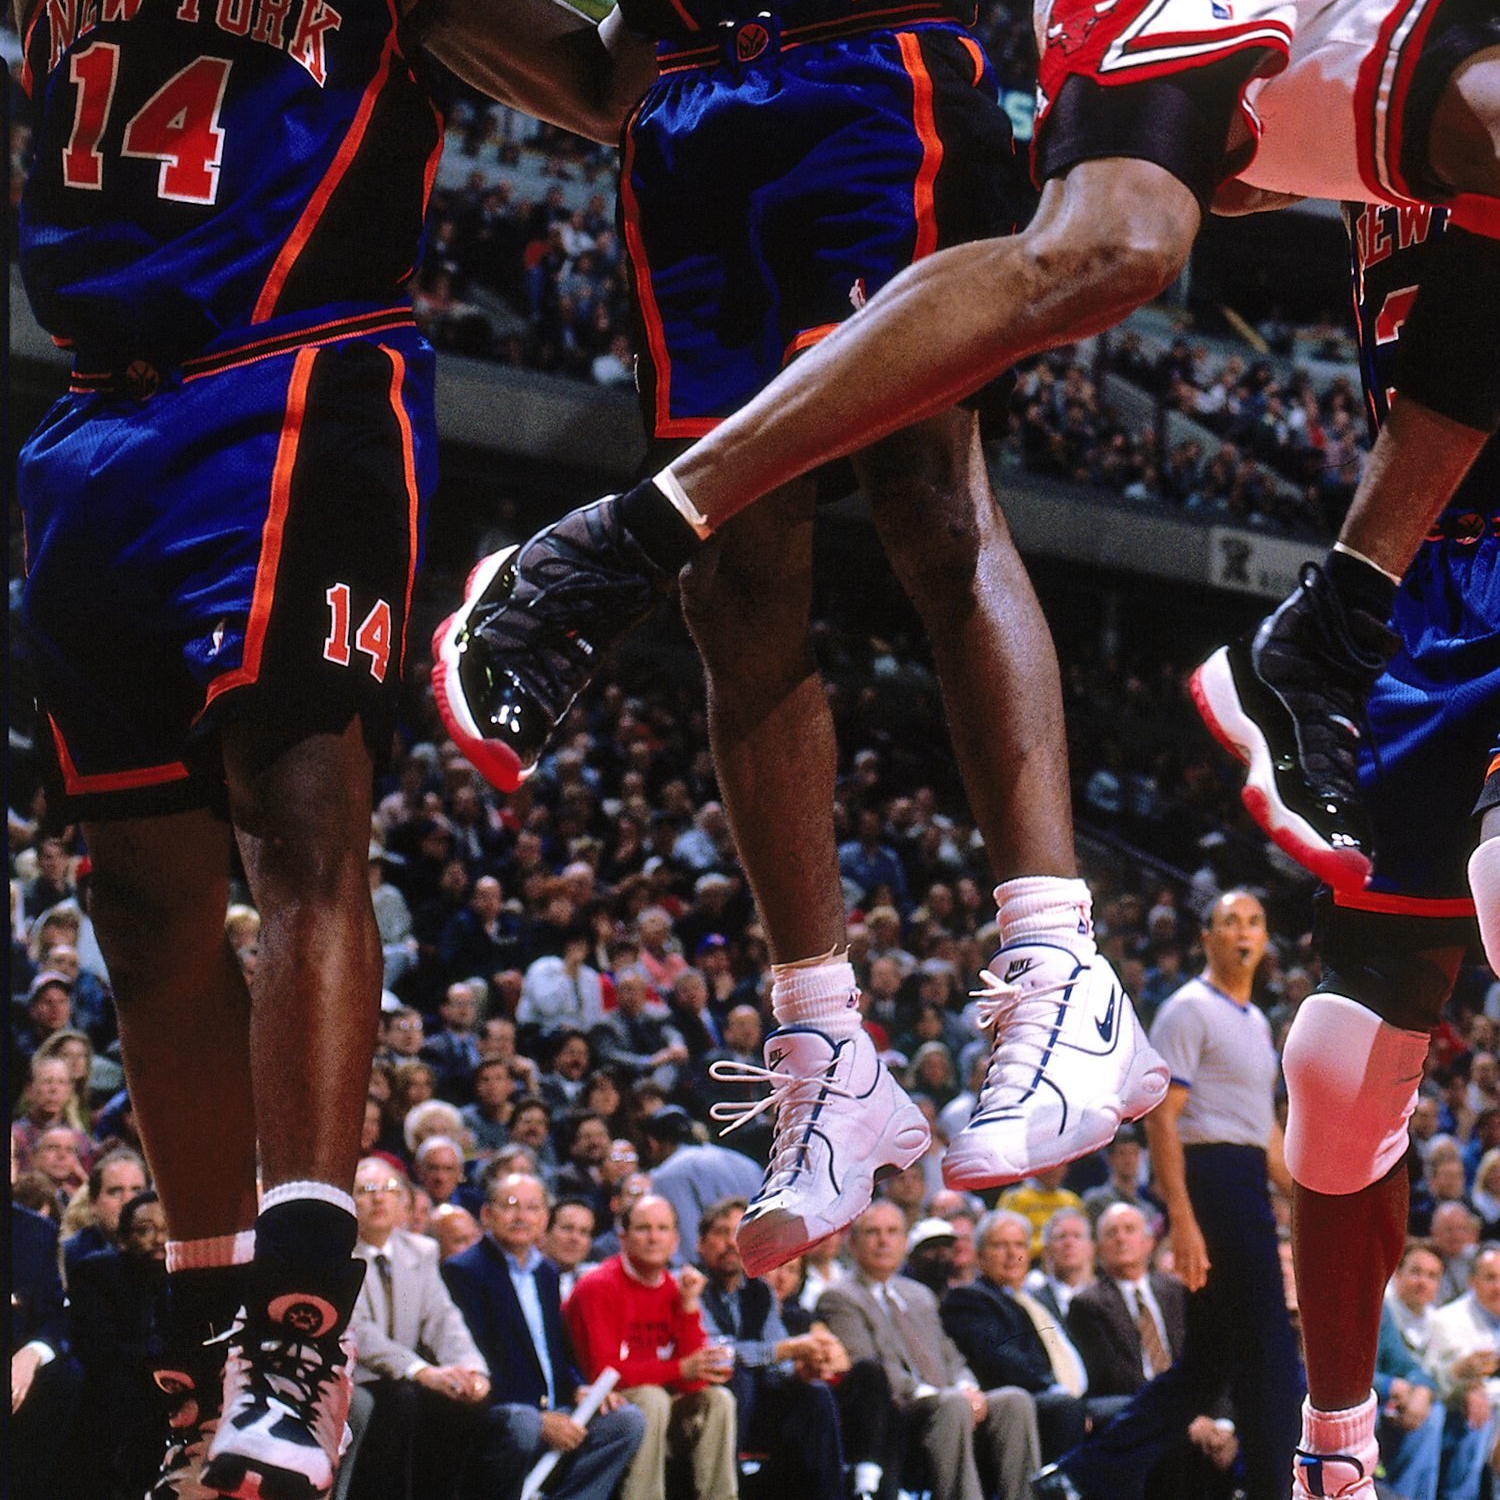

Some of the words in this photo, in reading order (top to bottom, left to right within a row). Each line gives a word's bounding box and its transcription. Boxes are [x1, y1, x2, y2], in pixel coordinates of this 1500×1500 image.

[62, 41, 234, 206] 14
[322, 582, 392, 684] 14
[1009, 957, 1033, 972] NIKE
